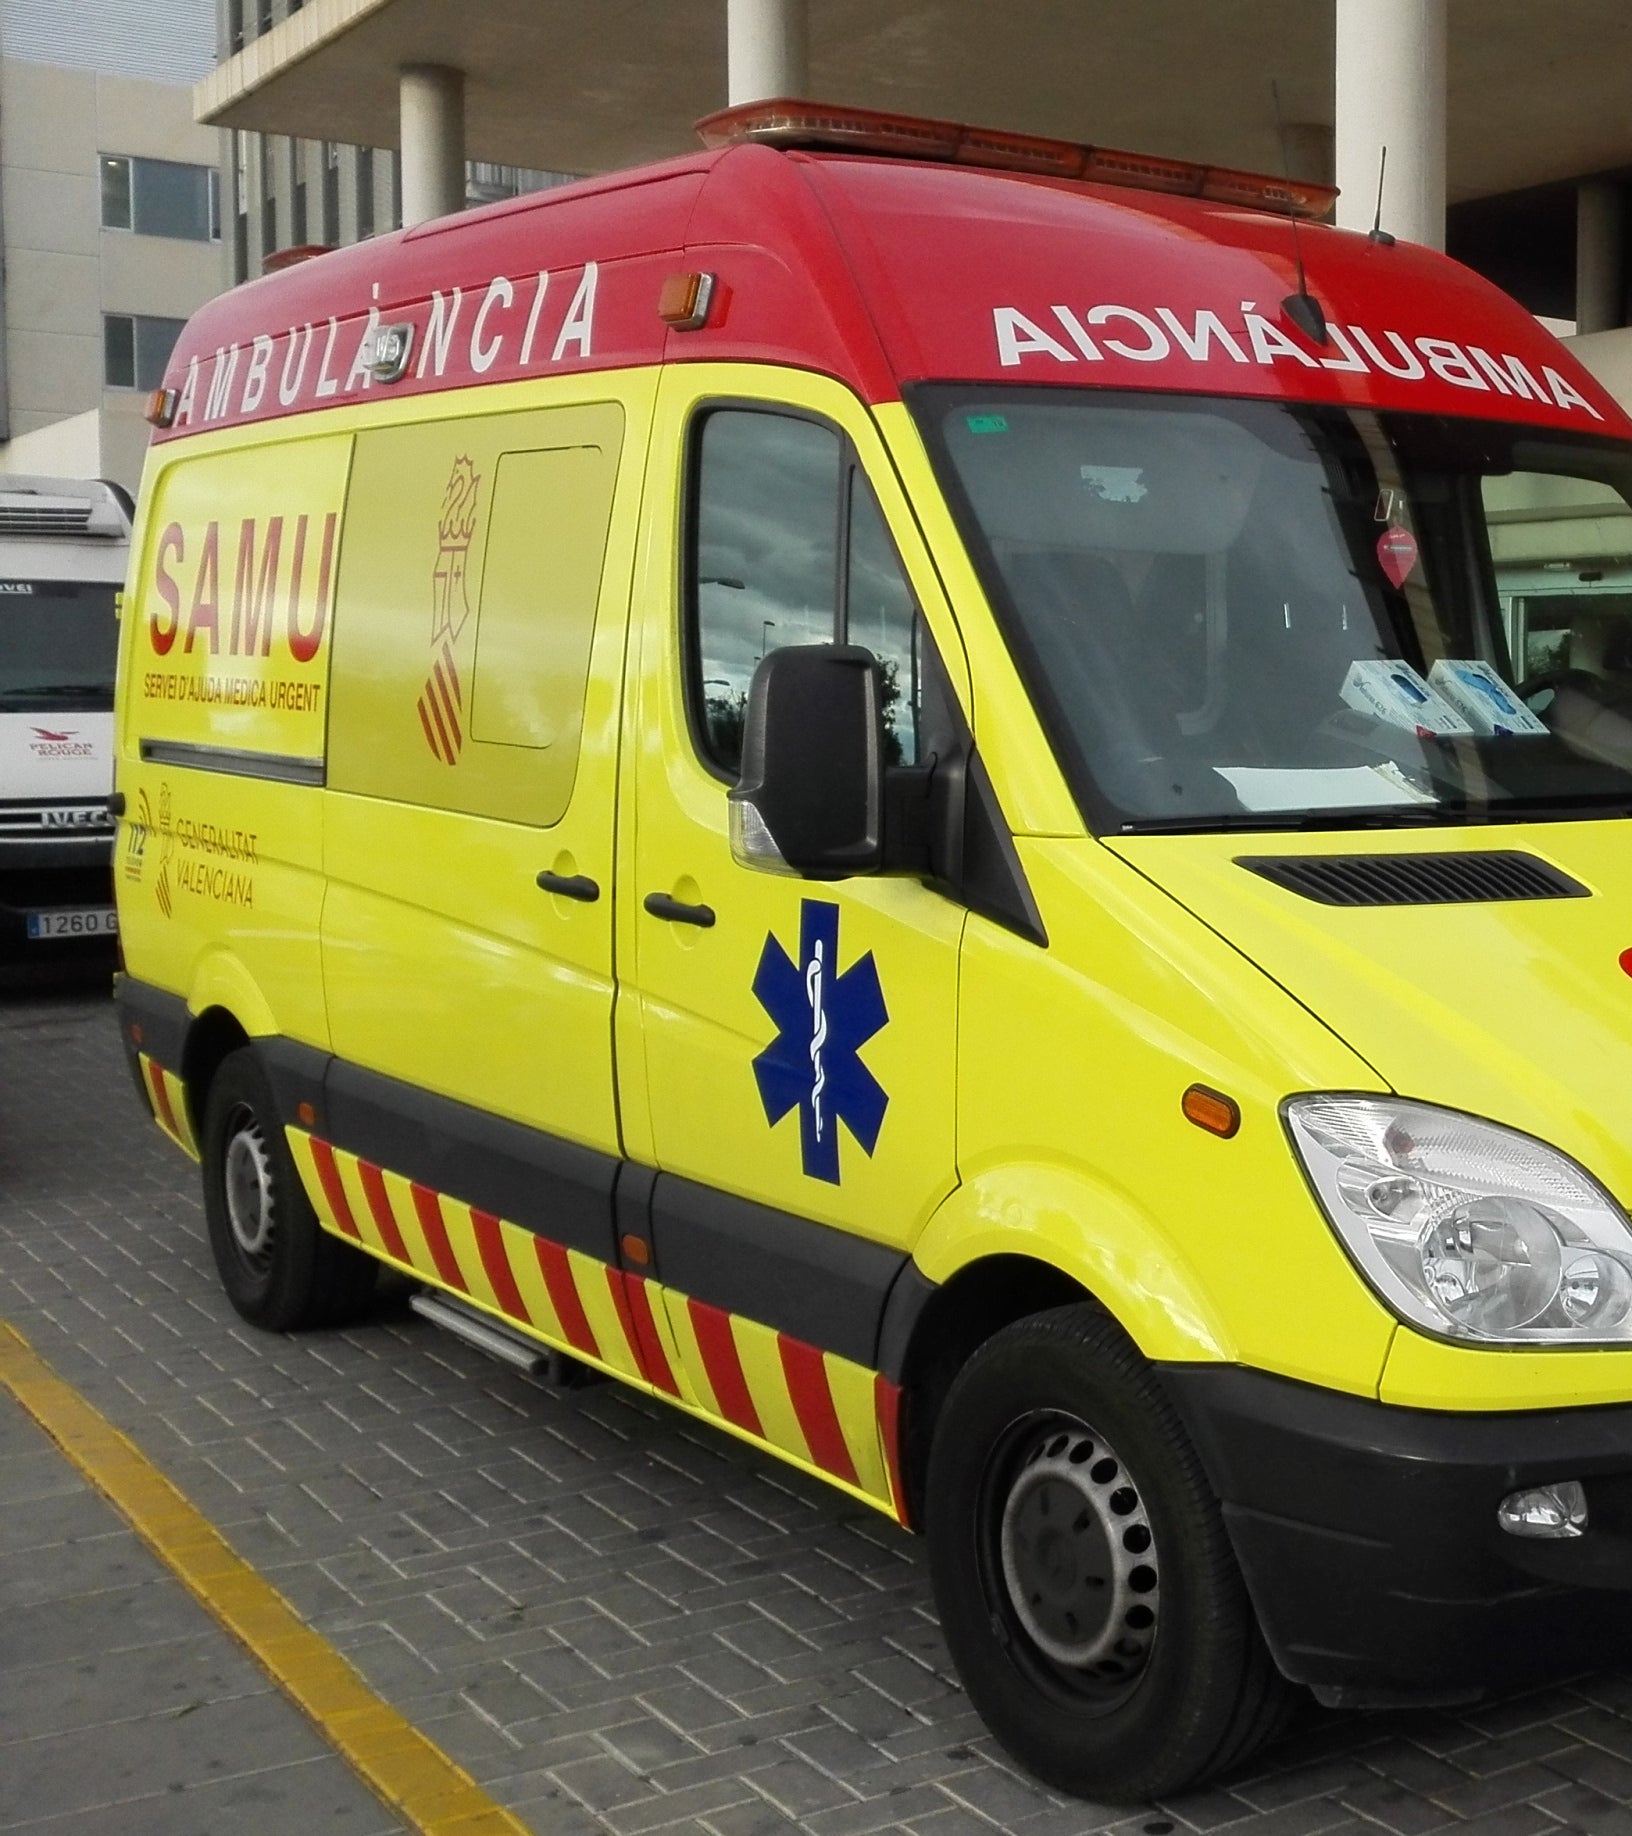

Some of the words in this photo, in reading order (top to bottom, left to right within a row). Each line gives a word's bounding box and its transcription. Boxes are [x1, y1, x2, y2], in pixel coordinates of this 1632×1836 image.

[150, 512, 337, 662] SAMU
[144, 672, 177, 699] SERVEI
[270, 680, 321, 712] URGENT
[30, 742, 93, 750] PELICAN
[38, 748, 92, 756] ROUGE
[128, 822, 147, 856] 112
[176, 818, 259, 865] GENERALITAT
[177, 858, 253, 909] VALENCIANA
[43, 914, 98, 934] 1260
